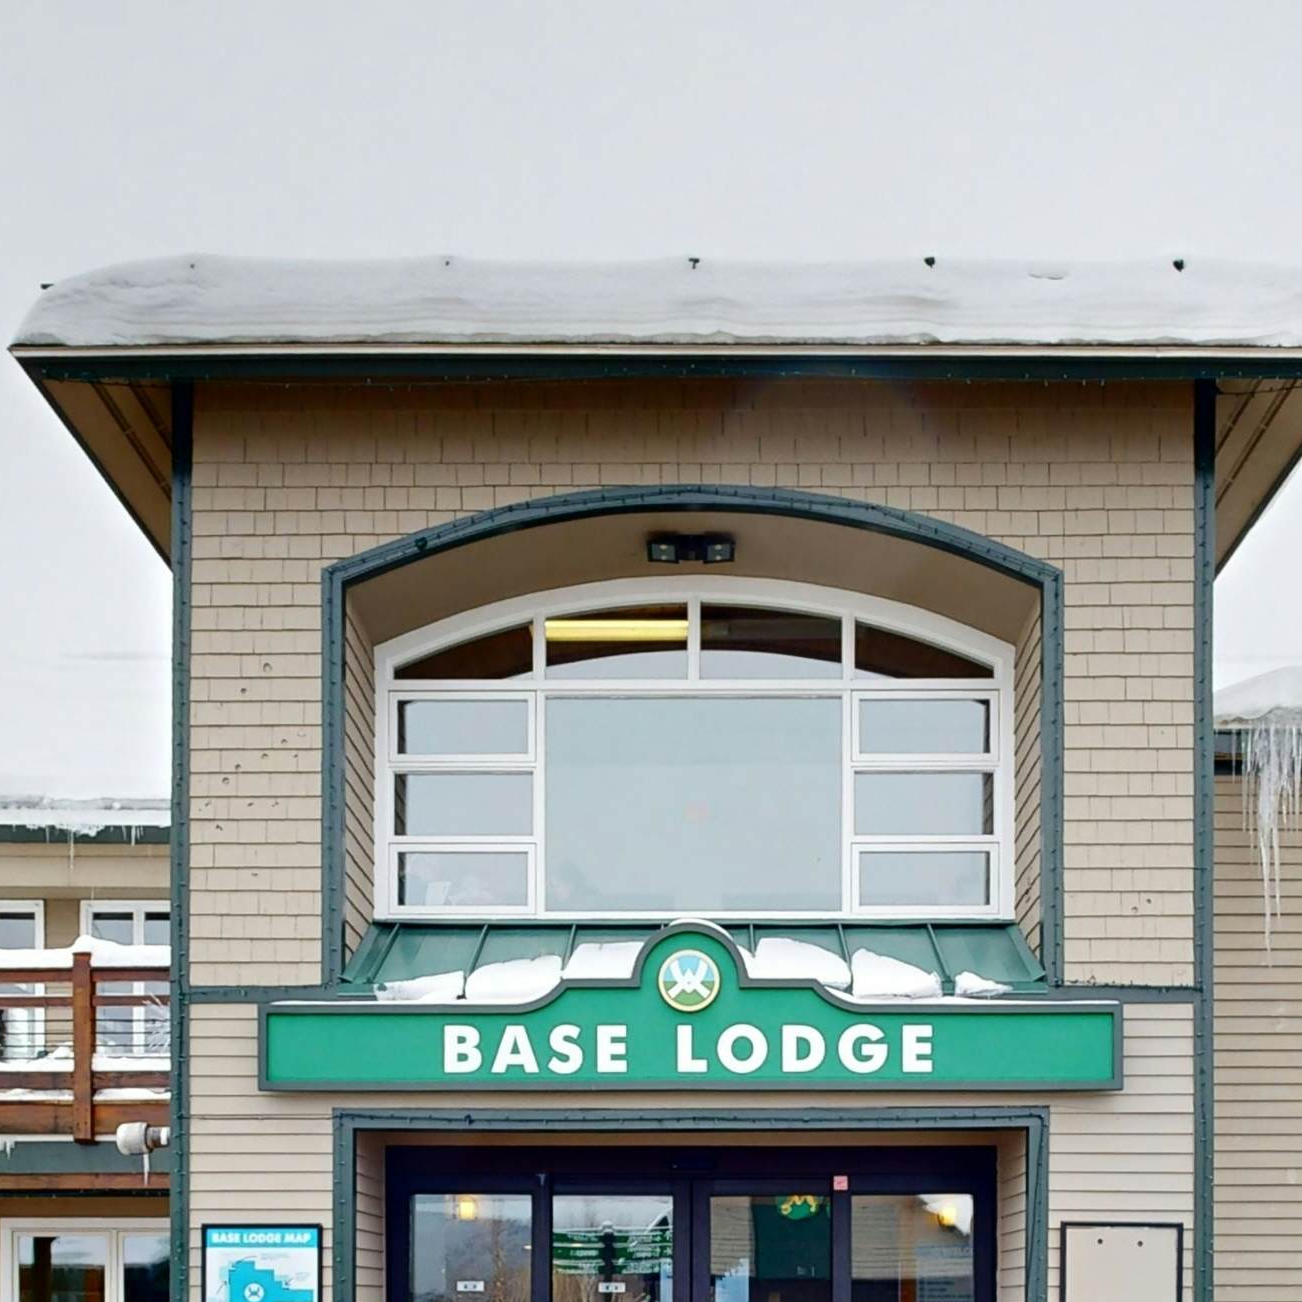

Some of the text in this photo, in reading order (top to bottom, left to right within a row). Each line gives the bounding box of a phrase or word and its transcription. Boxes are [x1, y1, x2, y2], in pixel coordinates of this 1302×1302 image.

[442, 1023, 934, 1075] BASE LODGE
[211, 1232, 312, 1244] BASE LODGE MAP
